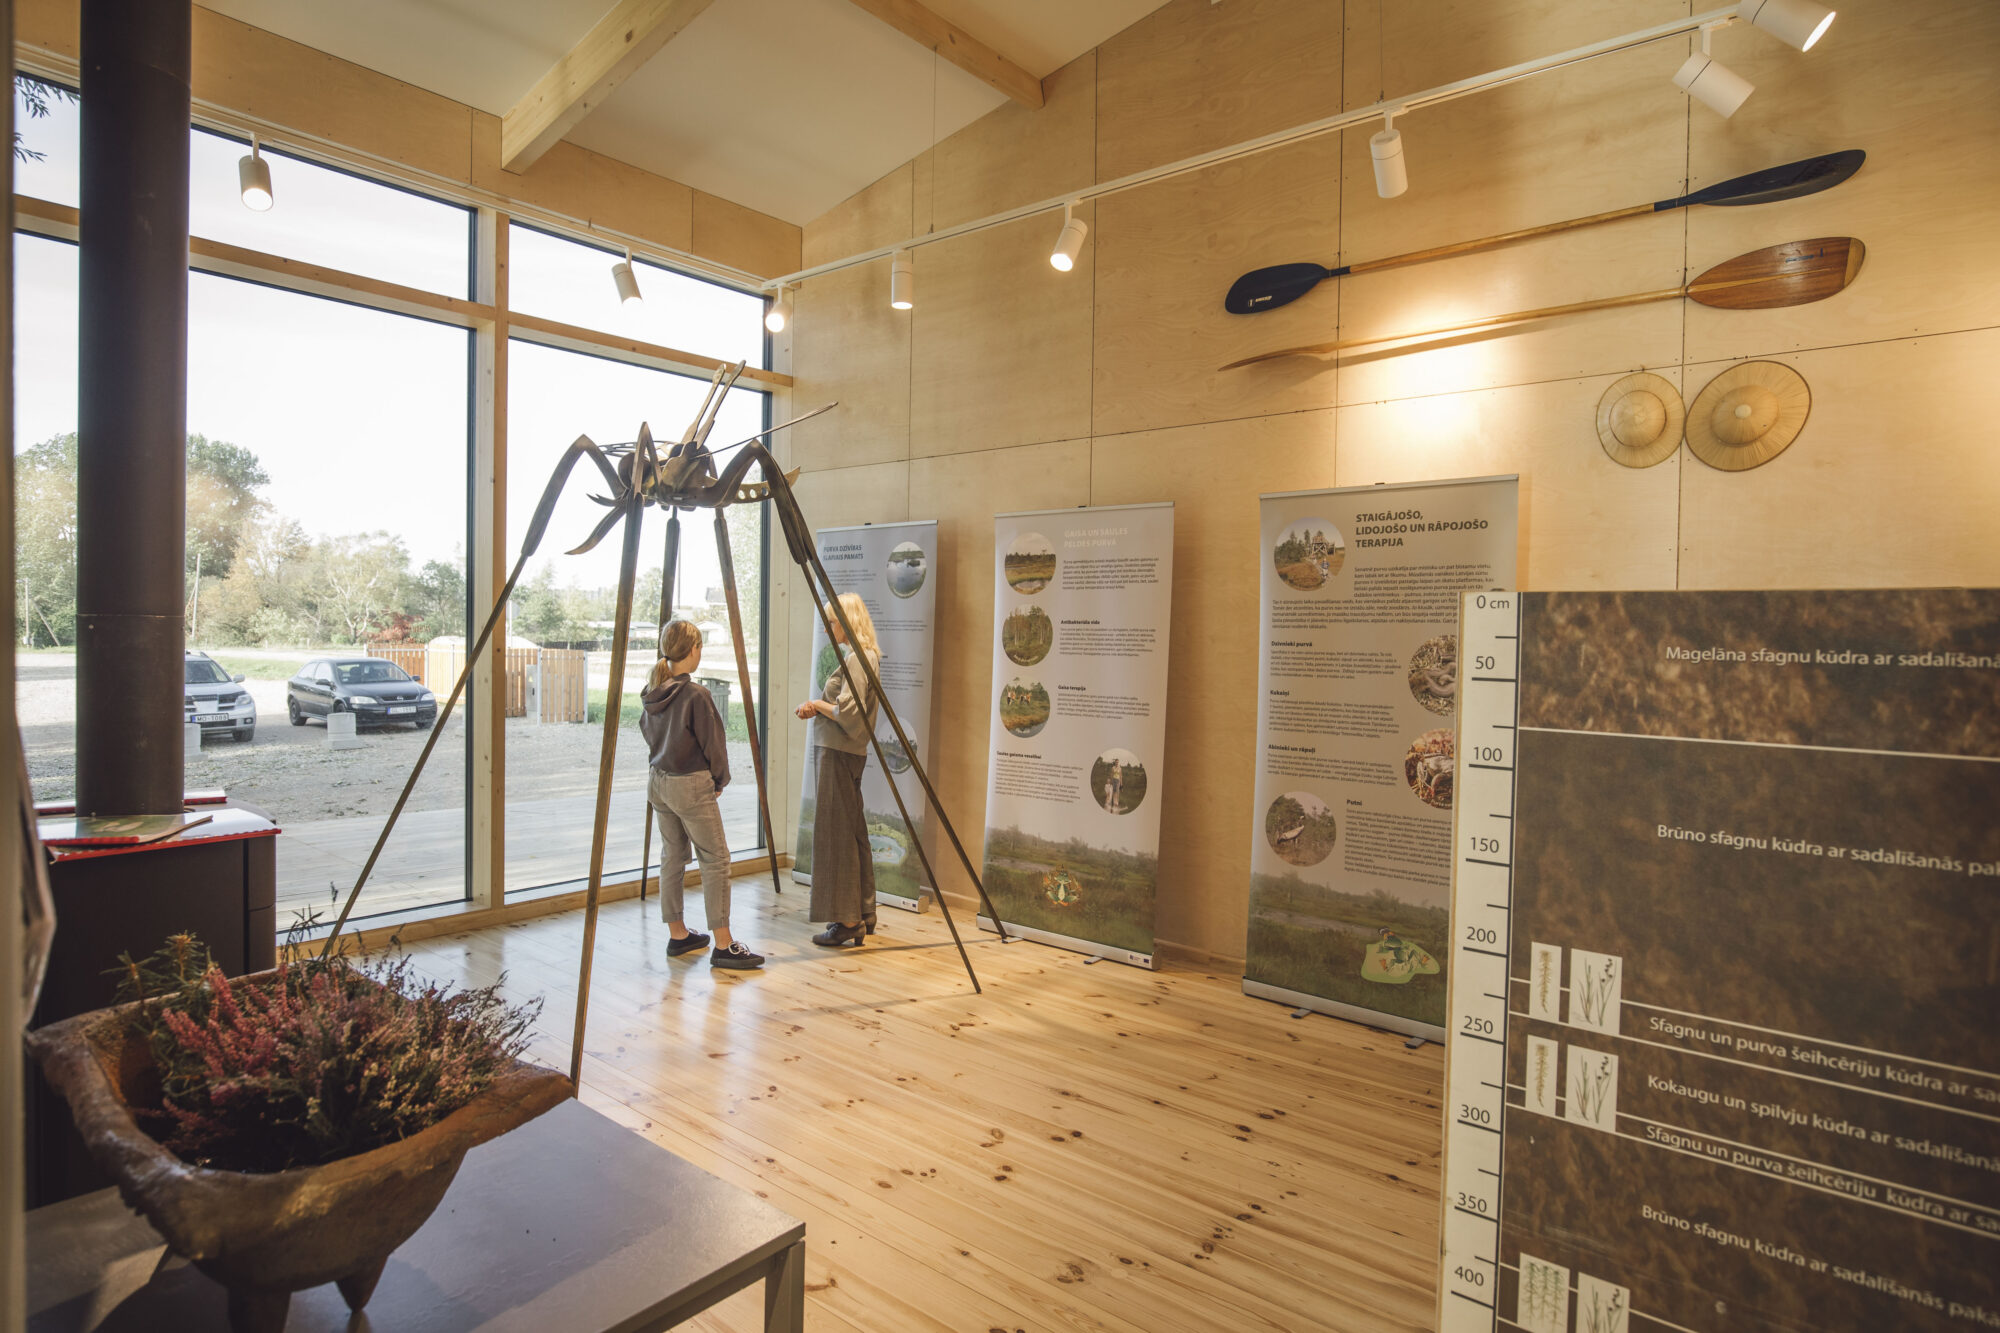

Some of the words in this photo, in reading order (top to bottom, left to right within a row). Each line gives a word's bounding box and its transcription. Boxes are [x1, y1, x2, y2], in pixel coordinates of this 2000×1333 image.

[1356, 510, 1424, 523] STAIGĀJOŠO,
[1356, 523, 1408, 536] LIDOJOŠO
[1410, 524, 1425, 533] UN
[1428, 518, 1488, 532] RĀPOJOŠO
[1355, 538, 1404, 548] TERAPIJA
[1476, 595, 1486, 609] 0
[1490, 598, 1510, 610] cm
[1474, 656, 1495, 670] 50
[1665, 646, 1746, 664] Magelāna
[1751, 648, 1811, 666] sfagnu
[1816, 650, 1870, 666] kūdra
[1874, 654, 1893, 666] ar
[1473, 746, 1502, 762] 100
[1470, 836, 1500, 854] 150
[1657, 824, 1706, 843] Brūno
[1710, 831, 1768, 851] sfagnu
[1772, 836, 1824, 857] kūdra
[1827, 844, 1846, 859] ar
[1850, 848, 1964, 872] sadalīšanās
[1466, 926, 1497, 945] 200
[1463, 1015, 1494, 1035] 250
[1650, 1016, 1706, 1042] Sfagnu
[1710, 1031, 1732, 1046] un
[1736, 1034, 1788, 1058] purva
[1791, 1046, 1881, 1078] šeihcēriju
[1886, 1064, 1944, 1092] kūdra
[1948, 1080, 1970, 1097] ar
[1460, 1104, 1491, 1124] 300
[1648, 1074, 1720, 1105] Kokaugu
[1724, 1095, 1746, 1111] un
[1750, 1100, 1808, 1126] spilvju
[1812, 1113, 1868, 1140] kūdra
[1870, 1130, 1891, 1146] ar
[1646, 1126, 1703, 1152] Sfagnu
[1706, 1144, 1729, 1160] un
[1732, 1150, 1784, 1175] purva
[1787, 1162, 1878, 1200] šeihcēriju
[1886, 1188, 1946, 1218] kūdra
[1948, 1207, 1971, 1225] ar
[1457, 1192, 1488, 1214] 350
[1642, 1204, 1691, 1231] Brūno
[1693, 1221, 1751, 1250] sfagnu
[1754, 1238, 1807, 1268] kūdra
[1810, 1258, 1830, 1274] ar
[1832, 1264, 1945, 1311] sadalīšanās
[1454, 1266, 1485, 1288] 400
